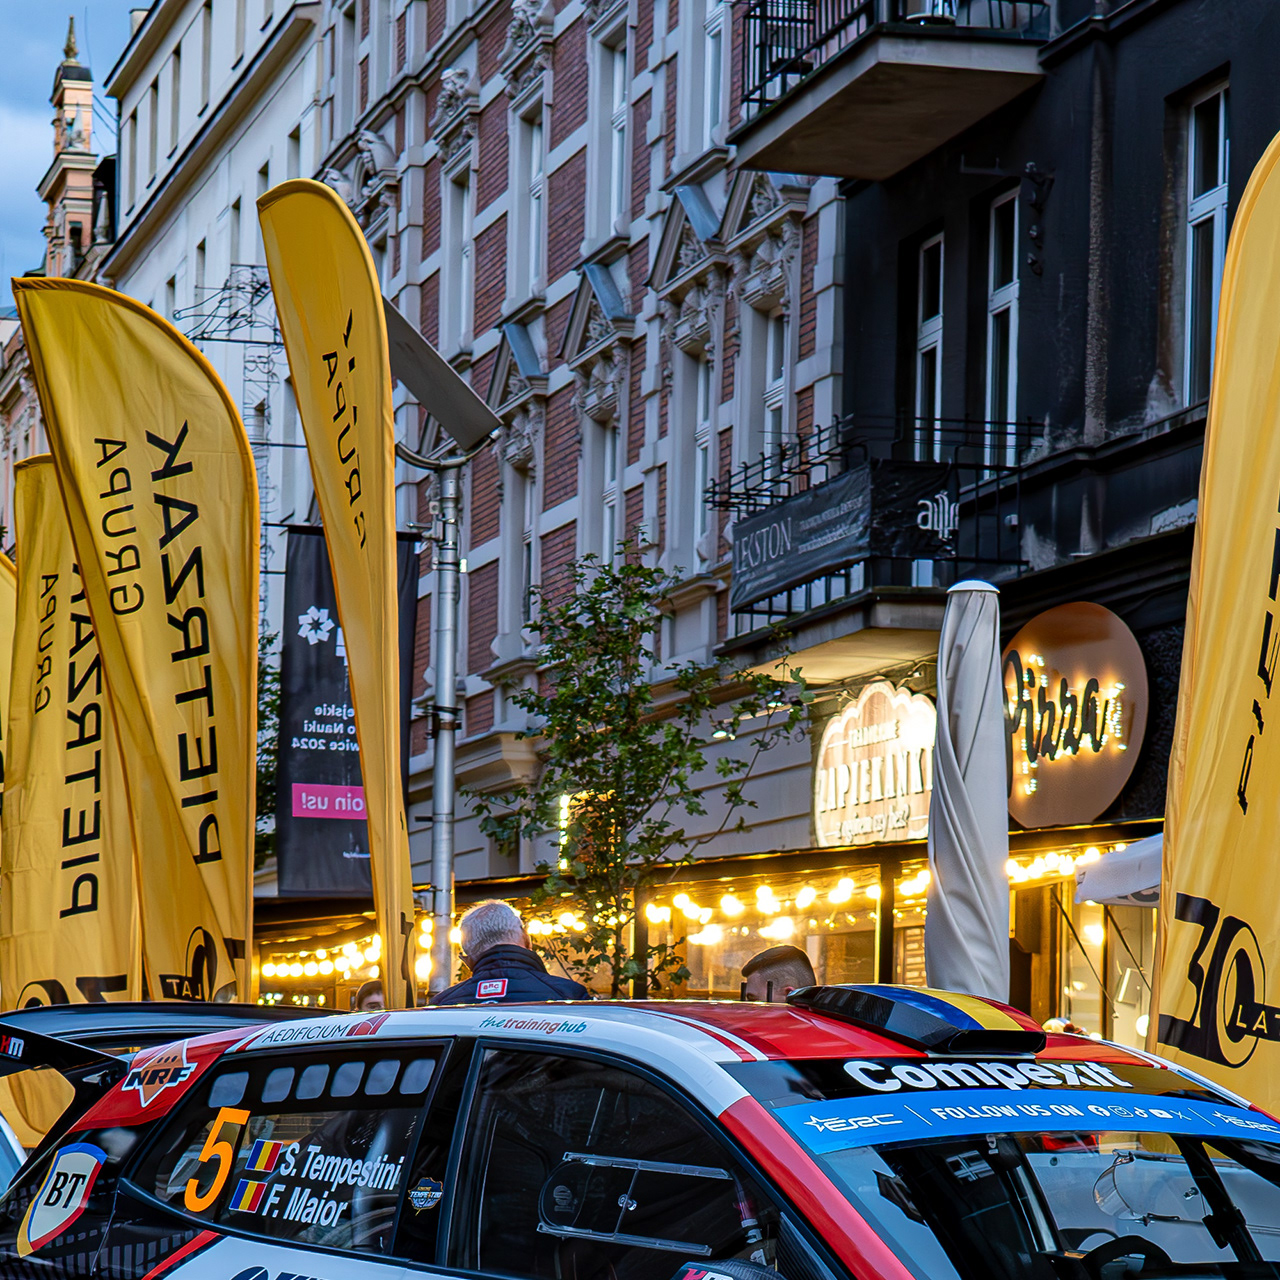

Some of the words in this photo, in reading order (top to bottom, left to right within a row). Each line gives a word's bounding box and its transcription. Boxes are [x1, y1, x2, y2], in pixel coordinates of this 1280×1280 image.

[1157, 891, 1266, 1069] 30
[262, 1024, 350, 1043] AEDIFICIUM
[478, 1016, 588, 1035] thetraininghub
[122, 1061, 198, 1092] NRF
[842, 1060, 1135, 1092] Compexit
[931, 1104, 1015, 1121] FOLLOW
[1017, 1104, 1052, 1118] US
[1054, 1103, 1078, 1118] ON
[183, 1106, 251, 1213] 5
[280, 1142, 297, 1177] S.
[300, 1144, 405, 1192] Tempestini
[44, 1170, 87, 1210] BT
[261, 1184, 280, 1218] F.
[283, 1186, 349, 1229] Maior
